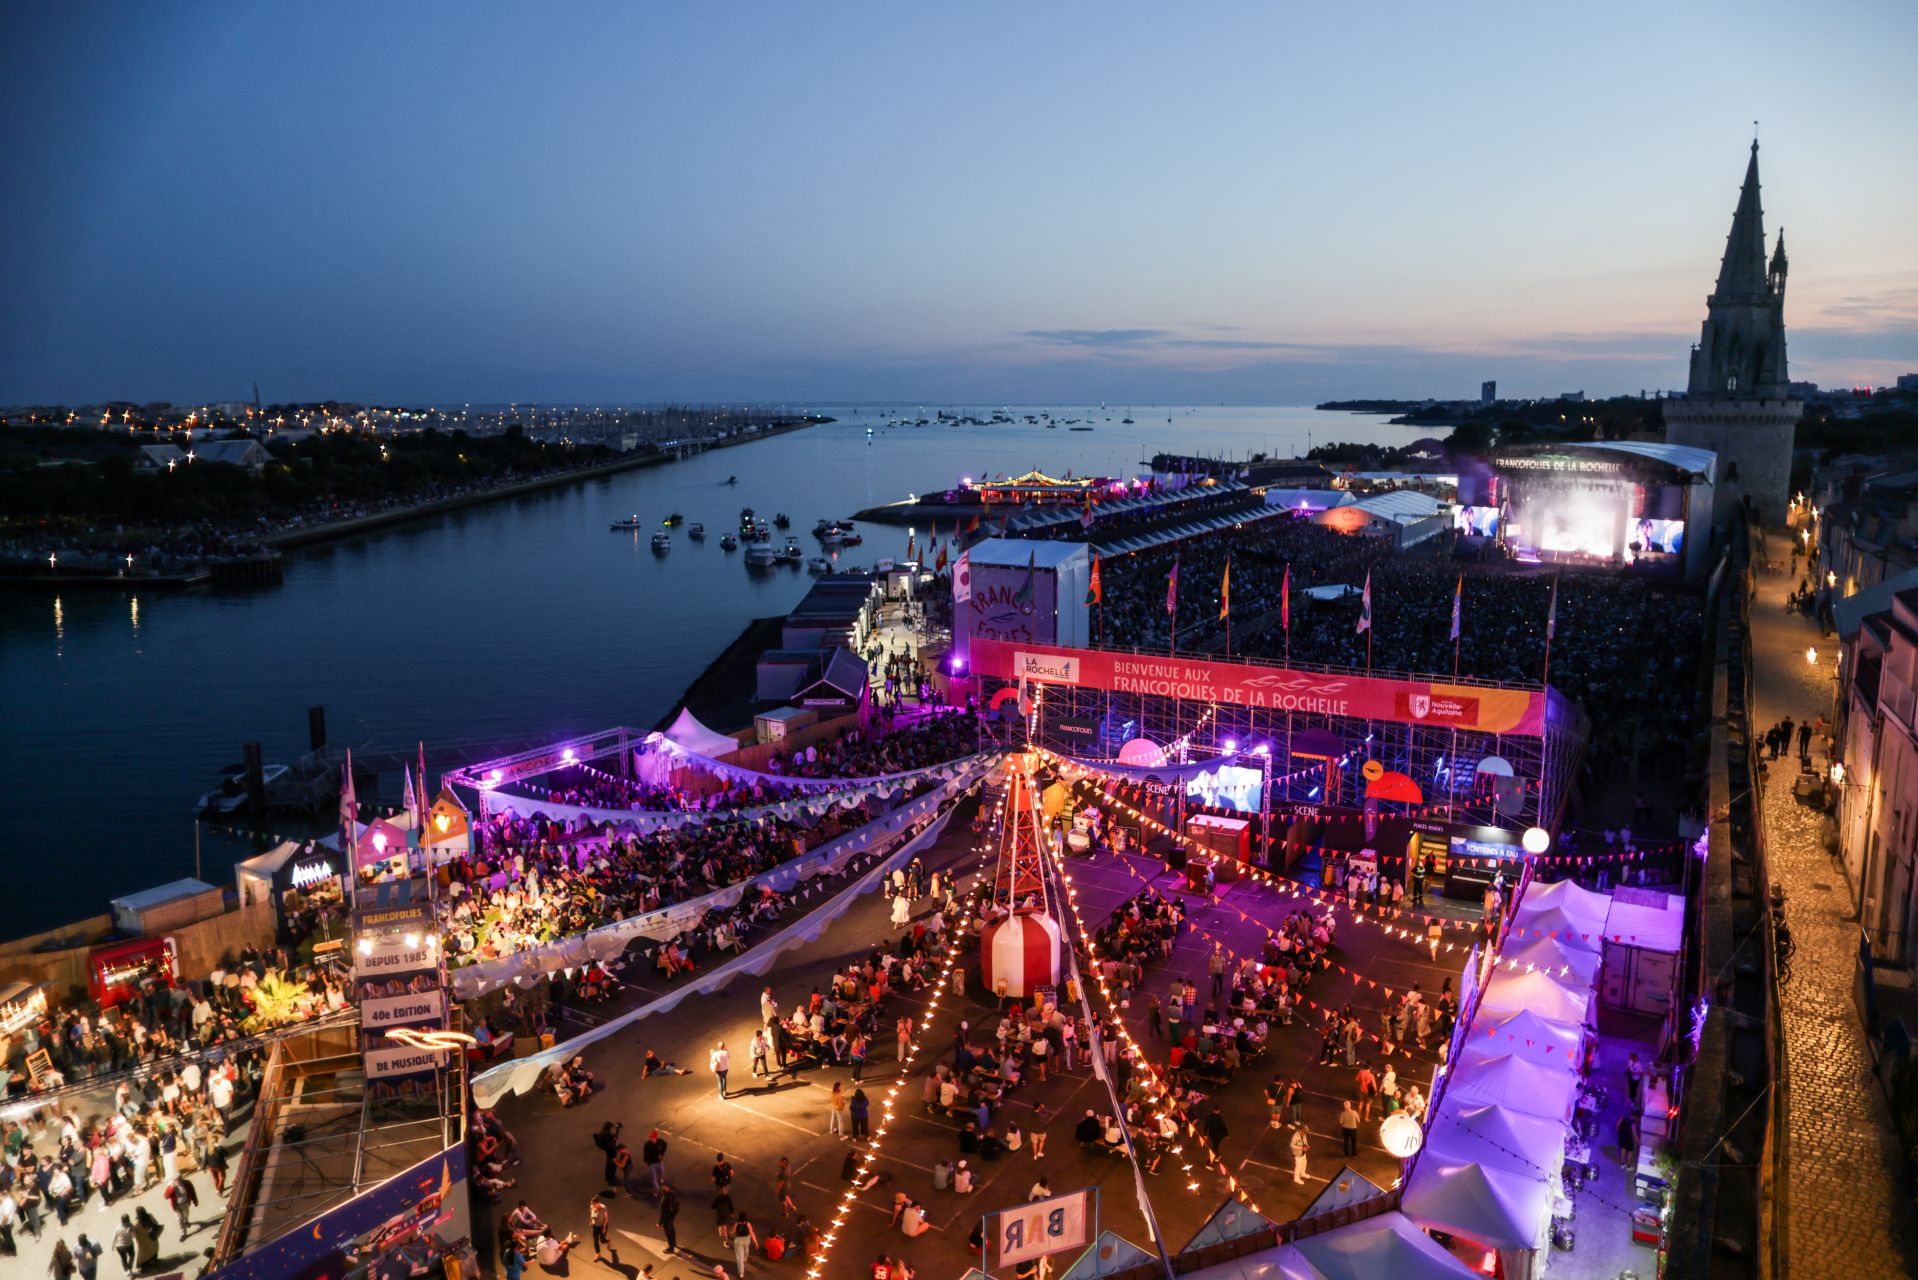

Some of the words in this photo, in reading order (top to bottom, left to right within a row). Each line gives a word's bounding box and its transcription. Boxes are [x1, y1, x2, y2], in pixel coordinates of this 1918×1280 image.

[1495, 458, 1551, 470] FRANCOFOLIES
[1553, 461, 1565, 471] DE
[1567, 461, 1577, 472] LA
[1580, 462, 1621, 473] ROCHELLE
[1026, 657, 1038, 666] LA
[1026, 665, 1070, 678] ROCHELLE
[1114, 661, 1180, 679] BIENVENUE
[1184, 668, 1211, 682] AUX
[1114, 677, 1216, 700] FRANCOFOLIES
[1223, 687, 1243, 704] DE
[1249, 690, 1265, 706] LA
[1272, 693, 1348, 716] ROCHELLE
[1431, 707, 1463, 717] Aquitaine
[1059, 724, 1093, 735] FRANCOFOLIES
[362, 908, 422, 925] FRANCOFOLIES
[365, 954, 400, 968] DEPUIS
[403, 950, 427, 964] 1985
[372, 1010, 391, 1021] 40e
[376, 1061, 389, 1073] DE
[391, 1053, 435, 1070] MUSIQUE
